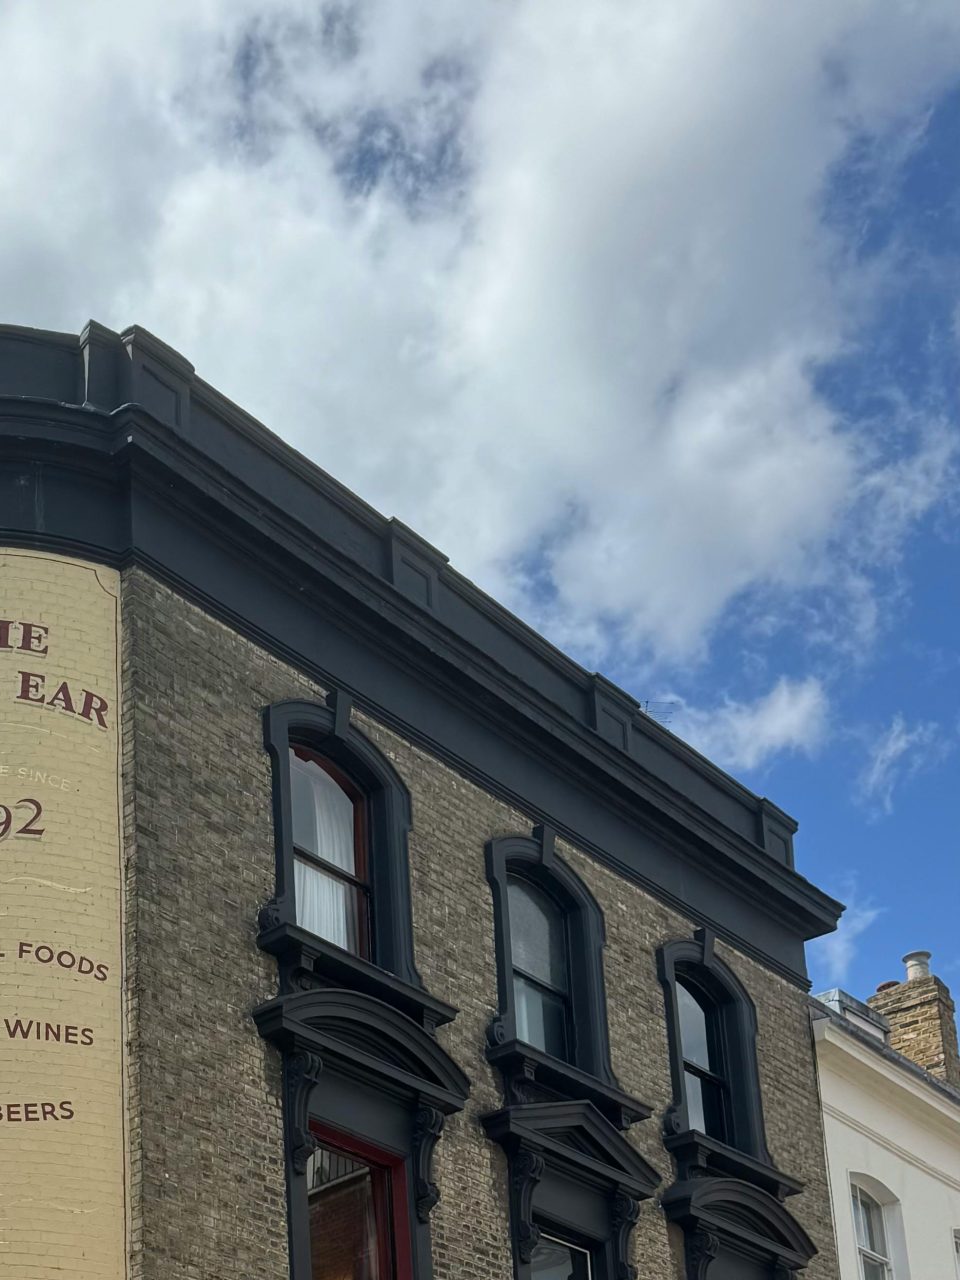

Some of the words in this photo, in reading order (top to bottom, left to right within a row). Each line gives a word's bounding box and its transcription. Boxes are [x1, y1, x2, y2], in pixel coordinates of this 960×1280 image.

[16, 671, 109, 728] EAR
[18, 941, 109, 982] FOODS
[4, 1018, 94, 1045] WINES
